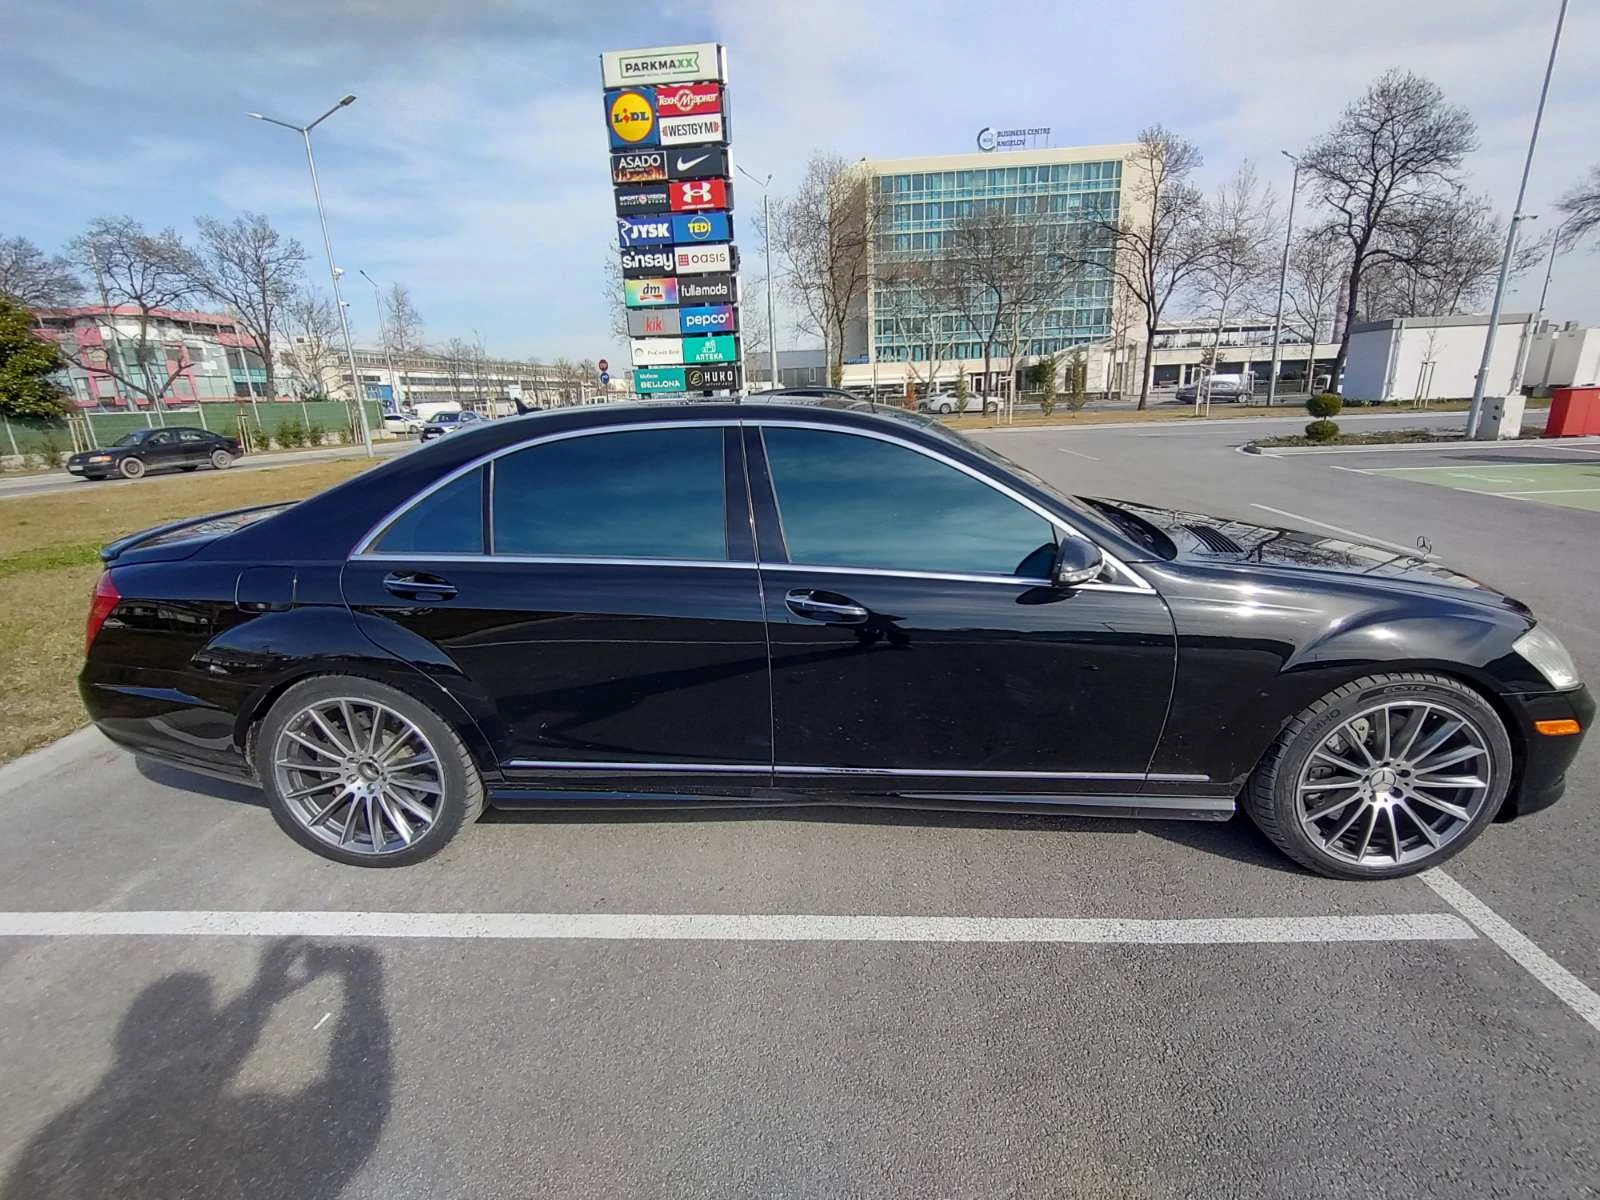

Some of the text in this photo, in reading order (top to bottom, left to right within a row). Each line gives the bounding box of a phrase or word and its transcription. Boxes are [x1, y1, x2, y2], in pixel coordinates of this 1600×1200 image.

[625, 57, 693, 73] PARKMAXX
[619, 154, 661, 169] ASADO
[630, 223, 671, 239] JYSK
[622, 251, 674, 271] sinsay
[691, 253, 727, 264] oasis
[642, 283, 661, 295] dm
[681, 283, 728, 297] fullamoda
[686, 312, 727, 327] pepco
[704, 370, 734, 382] HUKO
[640, 380, 681, 389] BELLONA
